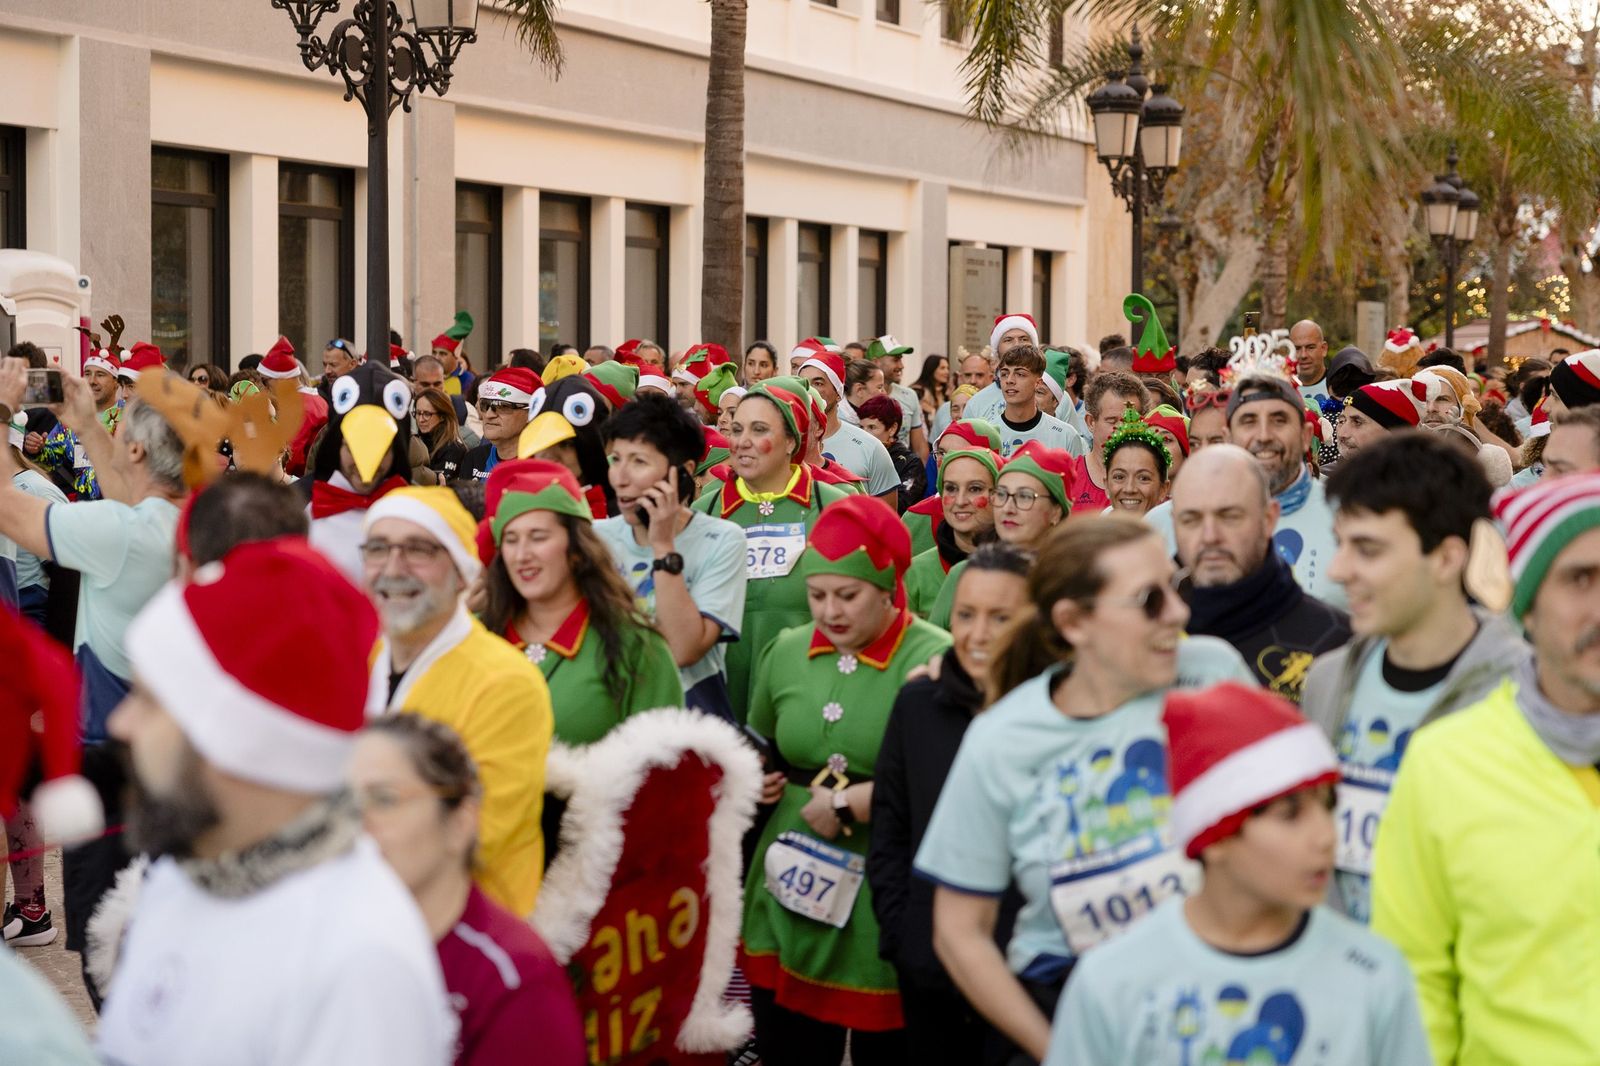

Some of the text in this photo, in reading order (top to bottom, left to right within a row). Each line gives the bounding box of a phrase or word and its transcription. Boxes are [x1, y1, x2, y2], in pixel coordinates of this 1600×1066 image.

[1226, 329, 1296, 368] 2025
[445, 461, 456, 471] HH
[747, 546, 786, 567] 678
[779, 866, 836, 902] 497
